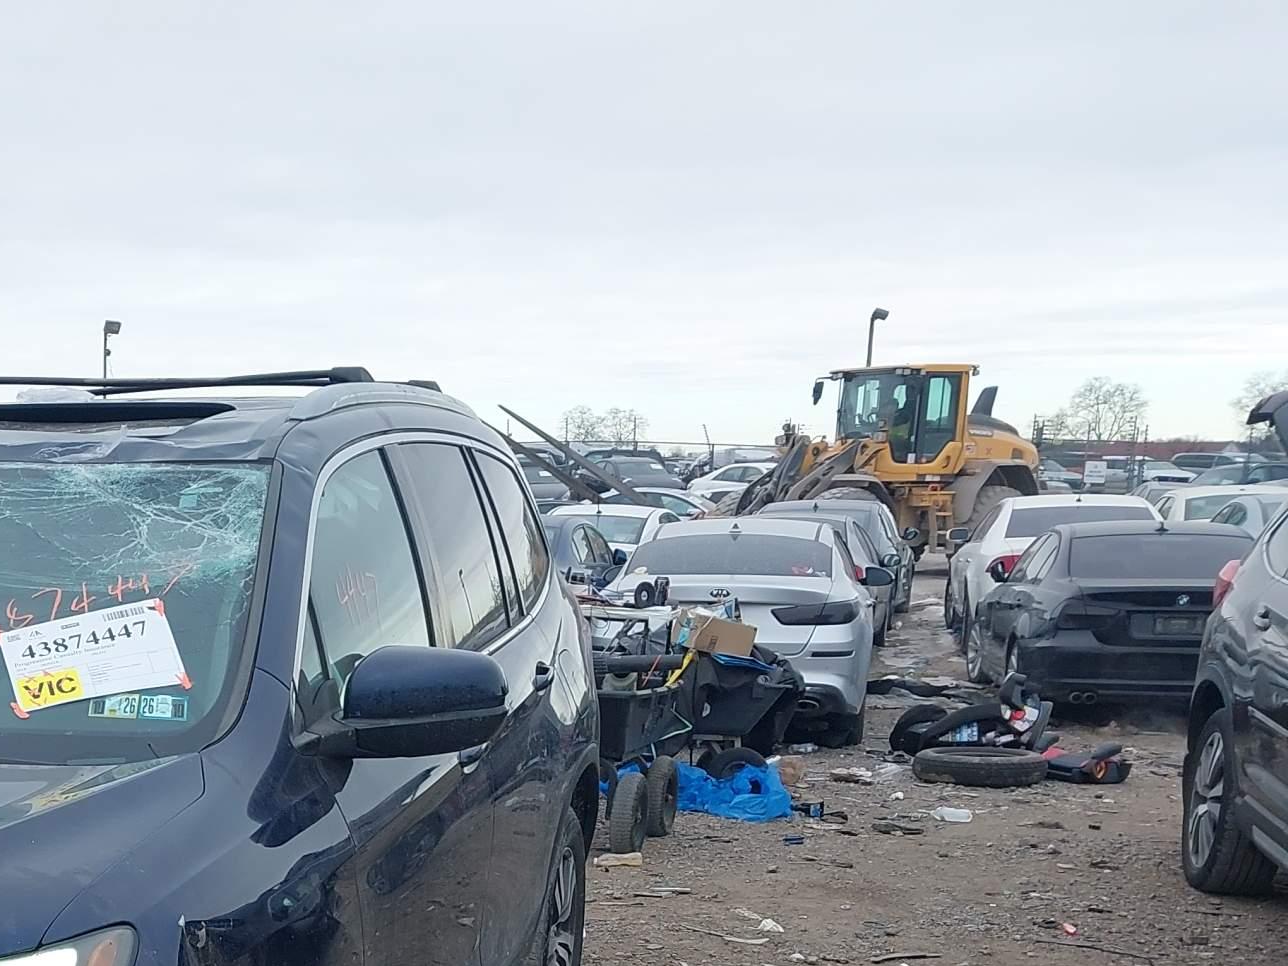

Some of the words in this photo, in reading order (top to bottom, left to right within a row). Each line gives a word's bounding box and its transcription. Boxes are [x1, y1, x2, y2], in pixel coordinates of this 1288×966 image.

[21, 620, 147, 659] 43874447
[23, 677, 77, 699] VIC
[123, 697, 137, 714] 26
[142, 697, 155, 714] 26
